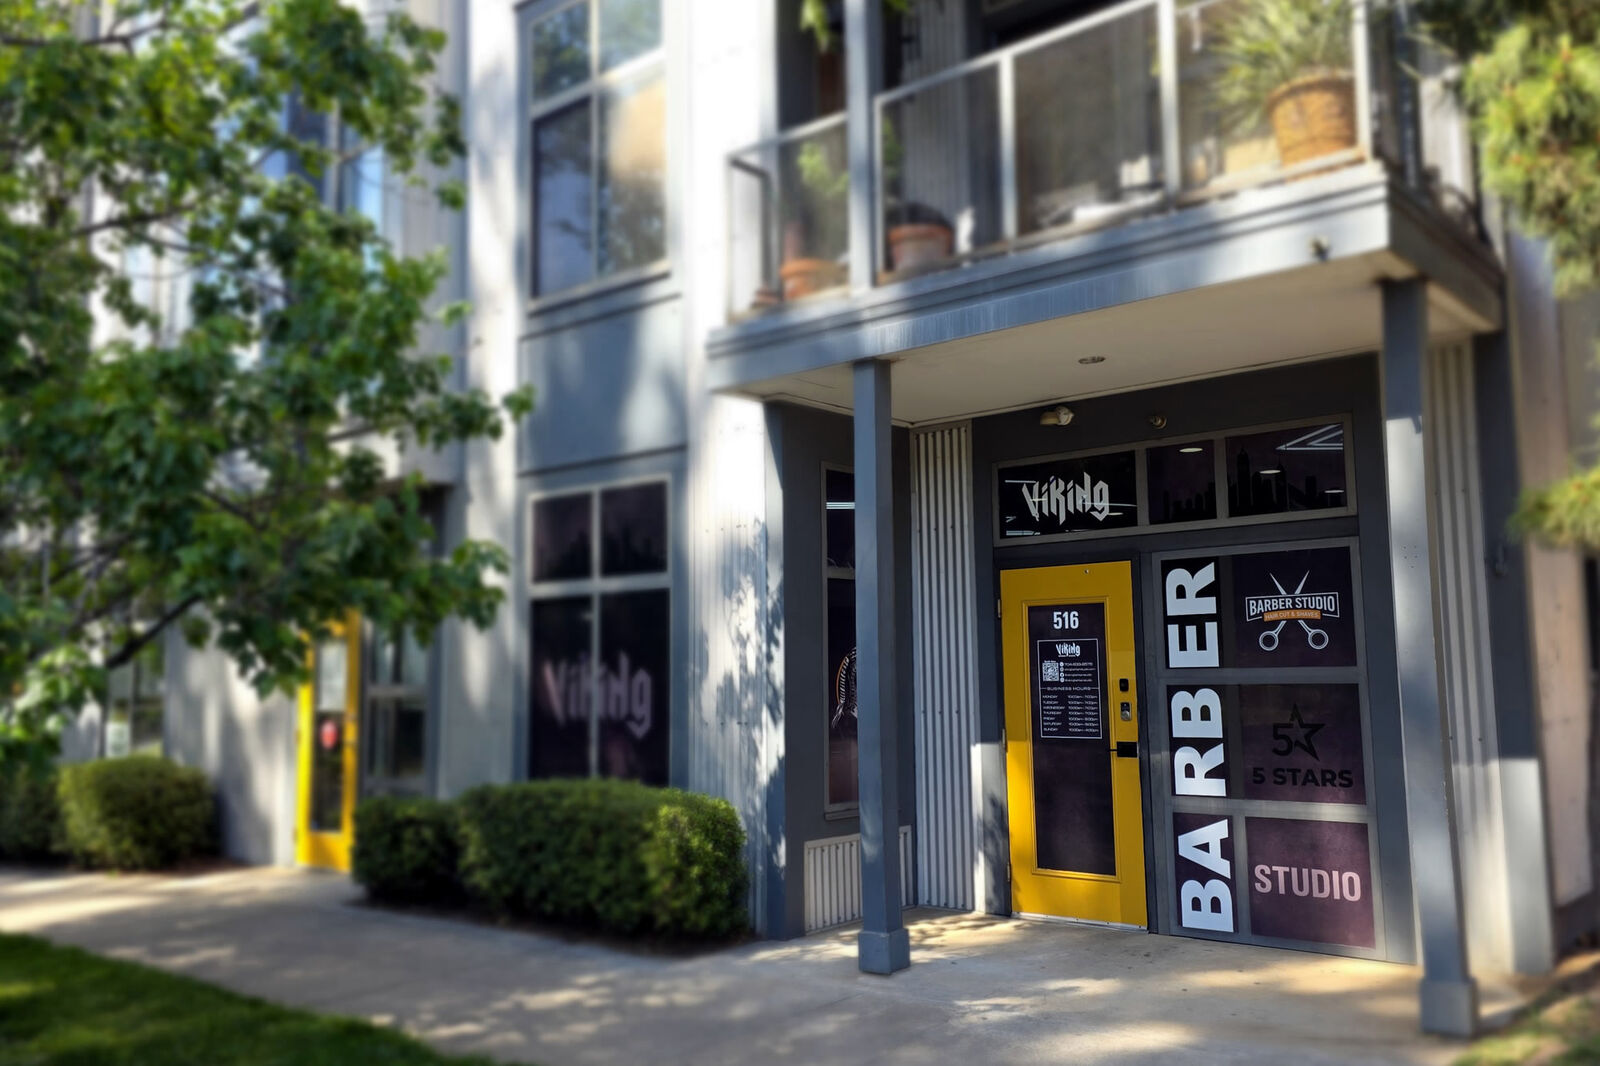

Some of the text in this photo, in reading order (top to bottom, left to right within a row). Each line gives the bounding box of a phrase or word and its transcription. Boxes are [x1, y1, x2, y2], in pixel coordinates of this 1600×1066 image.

[1249, 595, 1336, 616] BARBER STUDIO
[1053, 610, 1080, 629] 516
[1165, 561, 1235, 933] BARBER
[1252, 767, 1354, 788] 5 STARS
[1254, 864, 1362, 902] STUDIO
